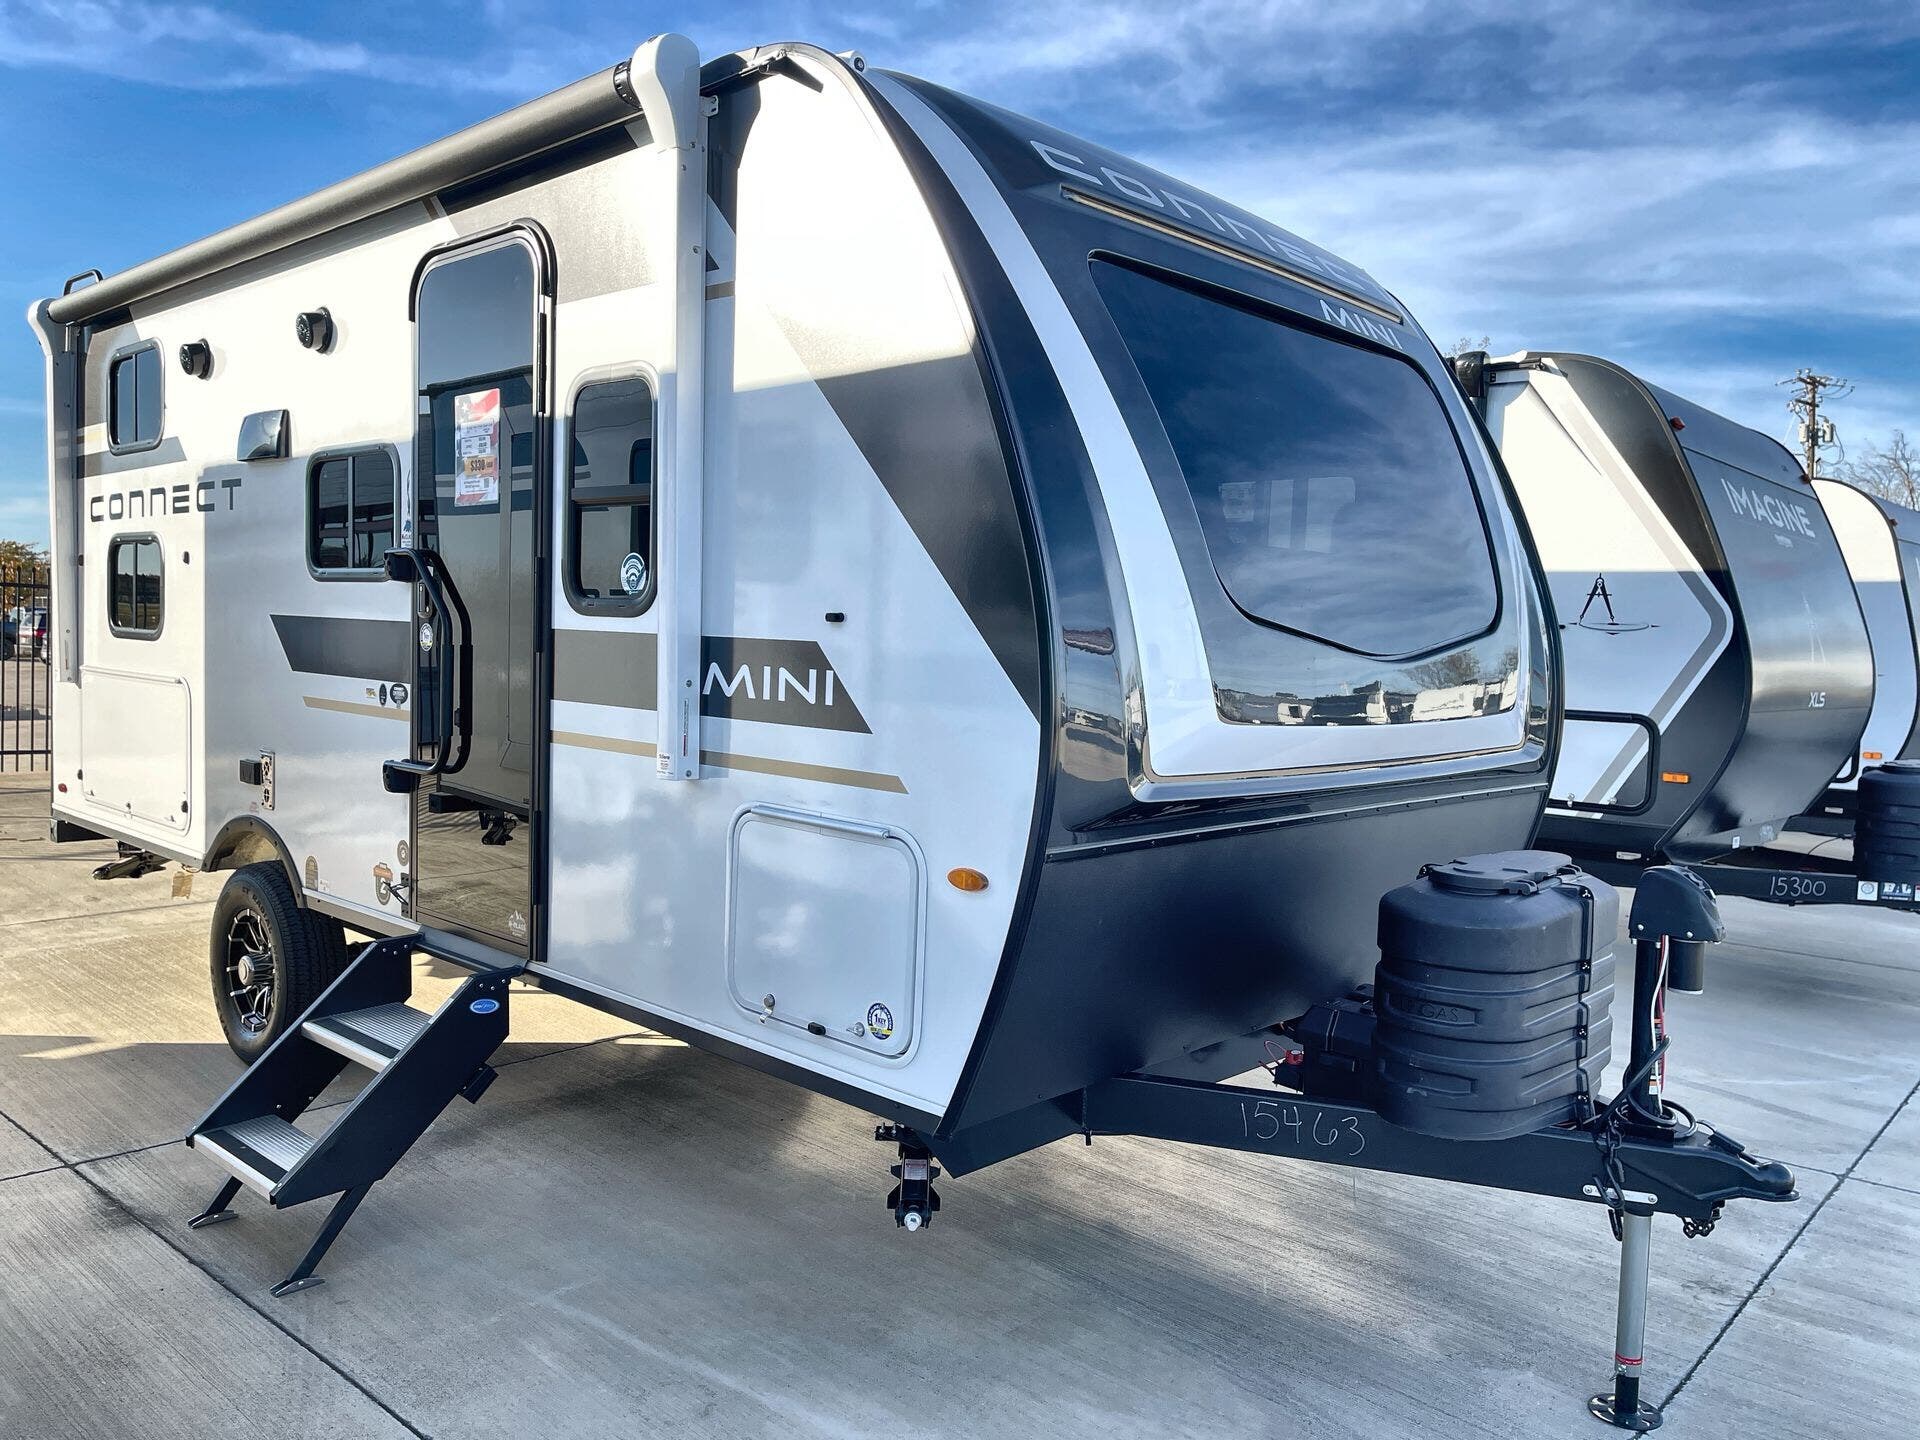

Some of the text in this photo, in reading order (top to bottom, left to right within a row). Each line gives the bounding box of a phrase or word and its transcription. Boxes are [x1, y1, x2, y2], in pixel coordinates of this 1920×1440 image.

[1319, 299, 1403, 350] MINI
[90, 478, 242, 523] CONNECT
[1720, 478, 1817, 538] IMAGINE
[702, 662, 834, 706] MINI
[1769, 876, 1827, 897] 15300
[1240, 1101, 1366, 1156] 15463
